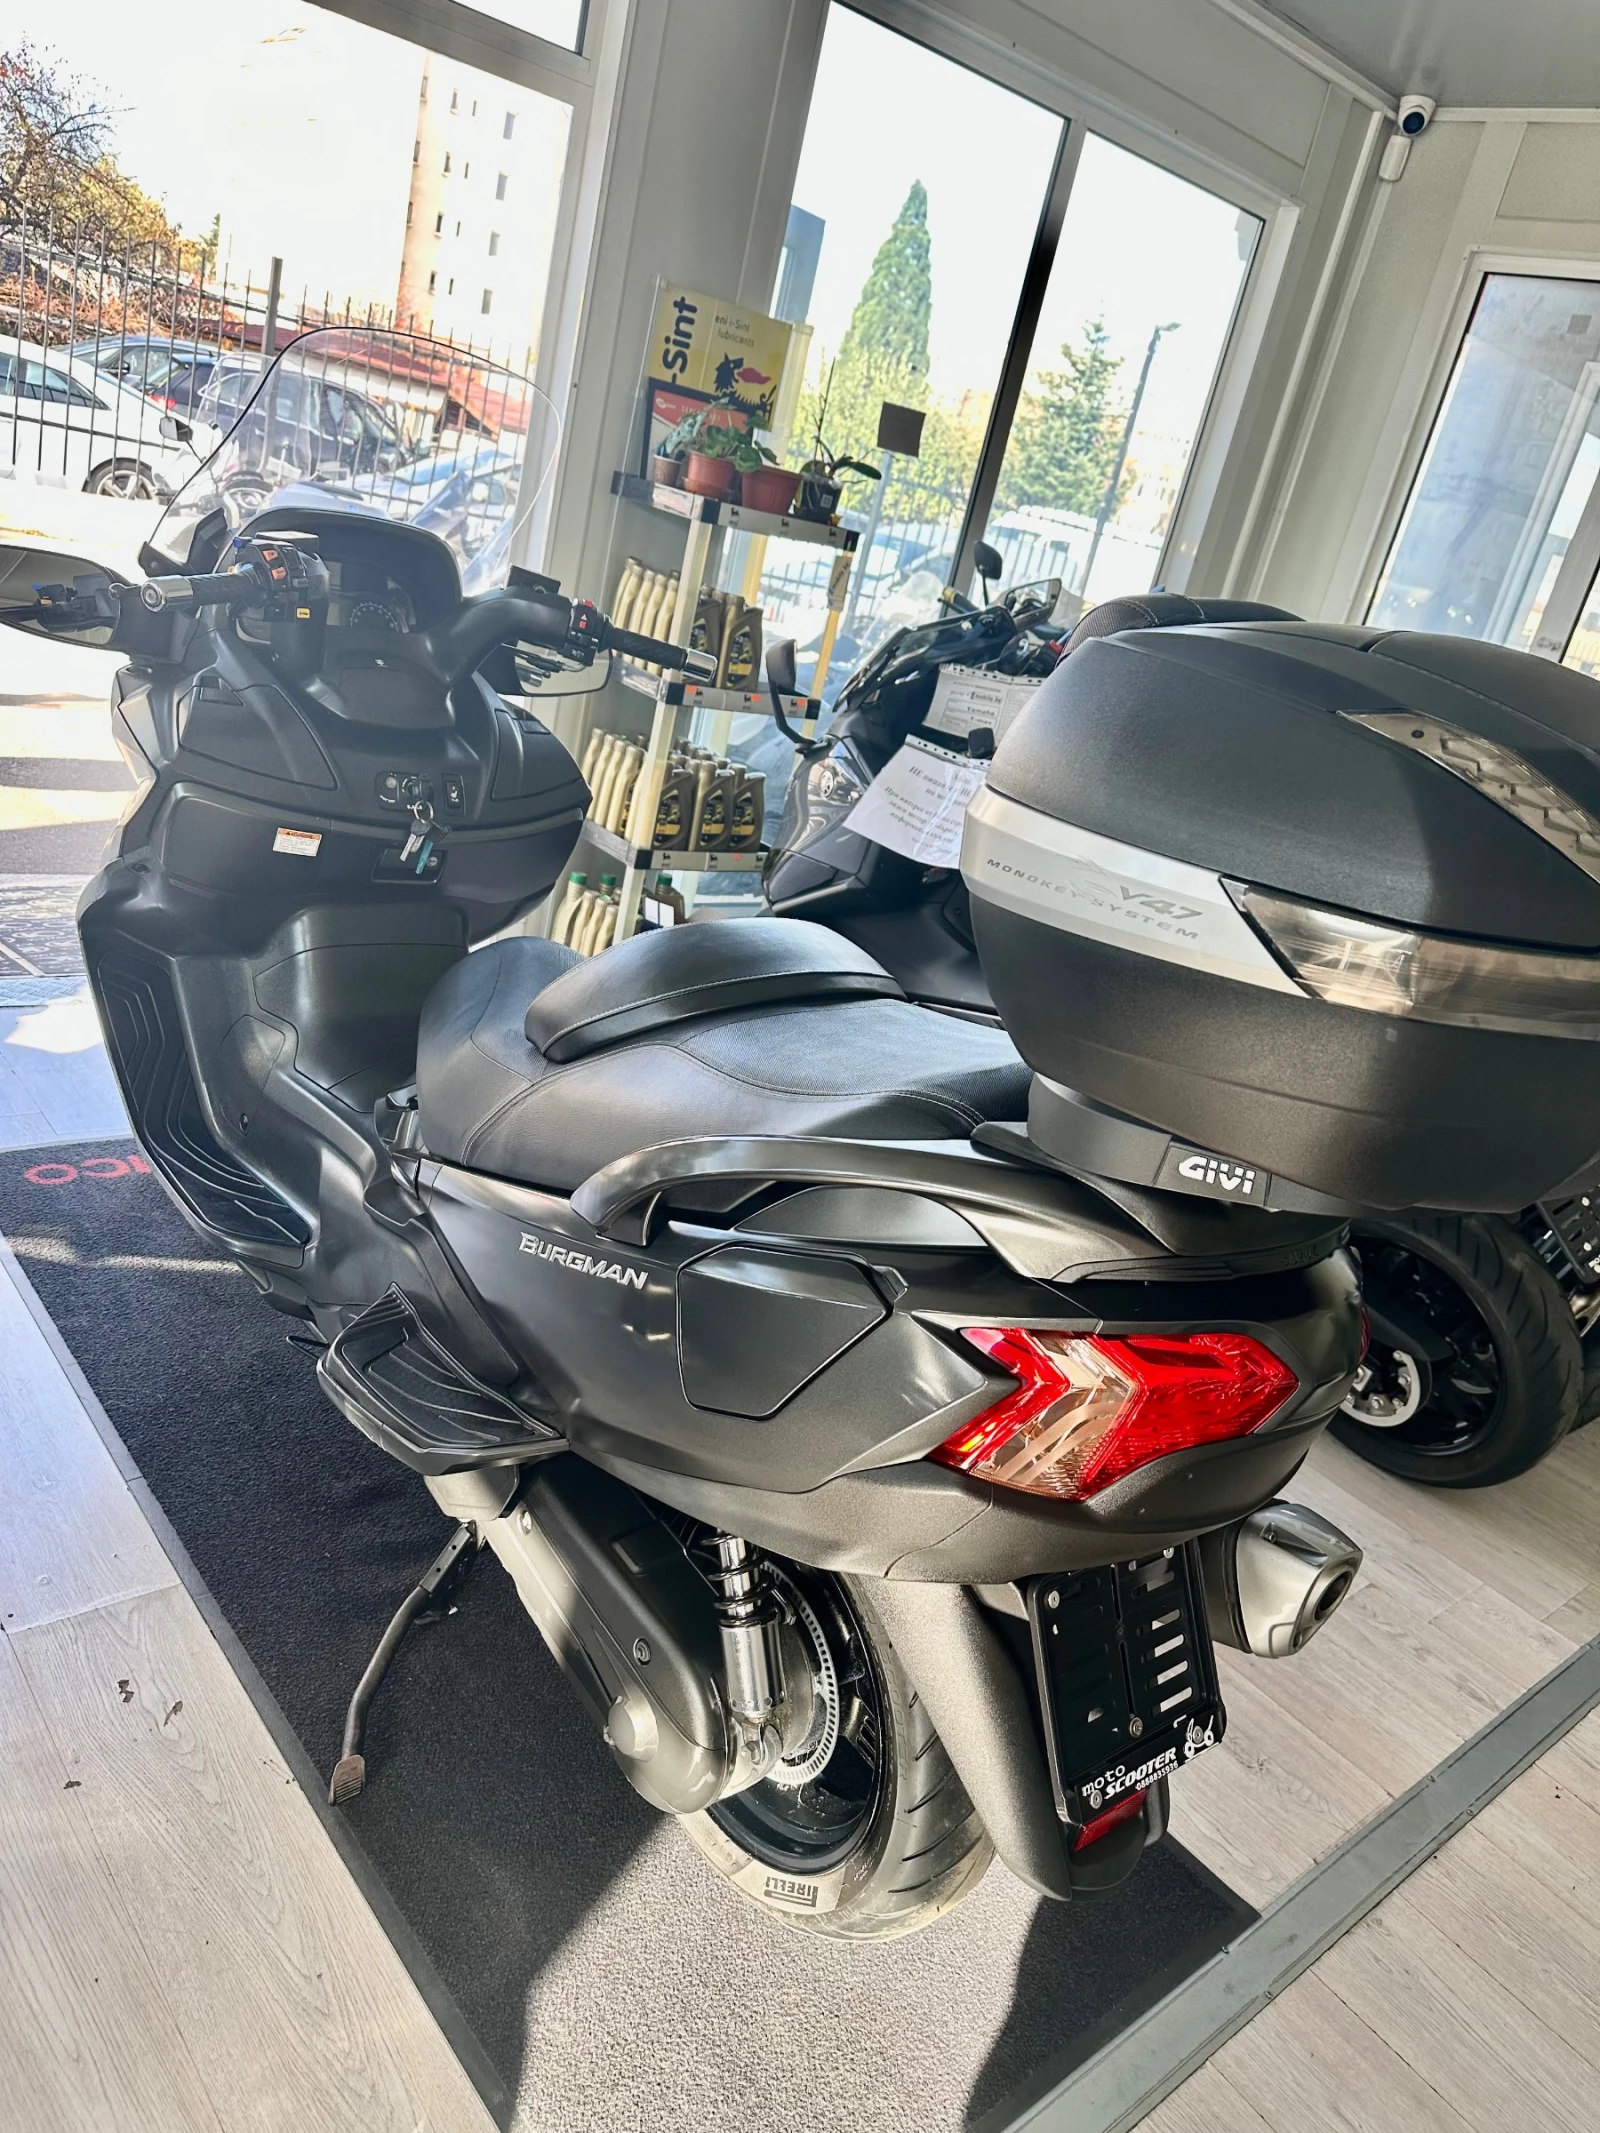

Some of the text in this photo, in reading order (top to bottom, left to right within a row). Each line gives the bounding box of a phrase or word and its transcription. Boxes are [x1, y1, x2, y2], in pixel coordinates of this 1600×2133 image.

[714, 314, 729, 325] eni
[717, 327, 755, 349] lubricants
[967, 706, 995, 717] Yamaha
[986, 857, 1200, 941] MONOKEY SYSTEM
[1178, 1155, 1257, 1196] GIVI
[518, 1231, 649, 1291] BURGMAN
[1081, 1763, 1127, 1798] moto
[1103, 1746, 1178, 1801] SCOOTER
[1135, 1762, 1179, 1791] 0888835936
[763, 1876, 819, 1908] PIRELLI
